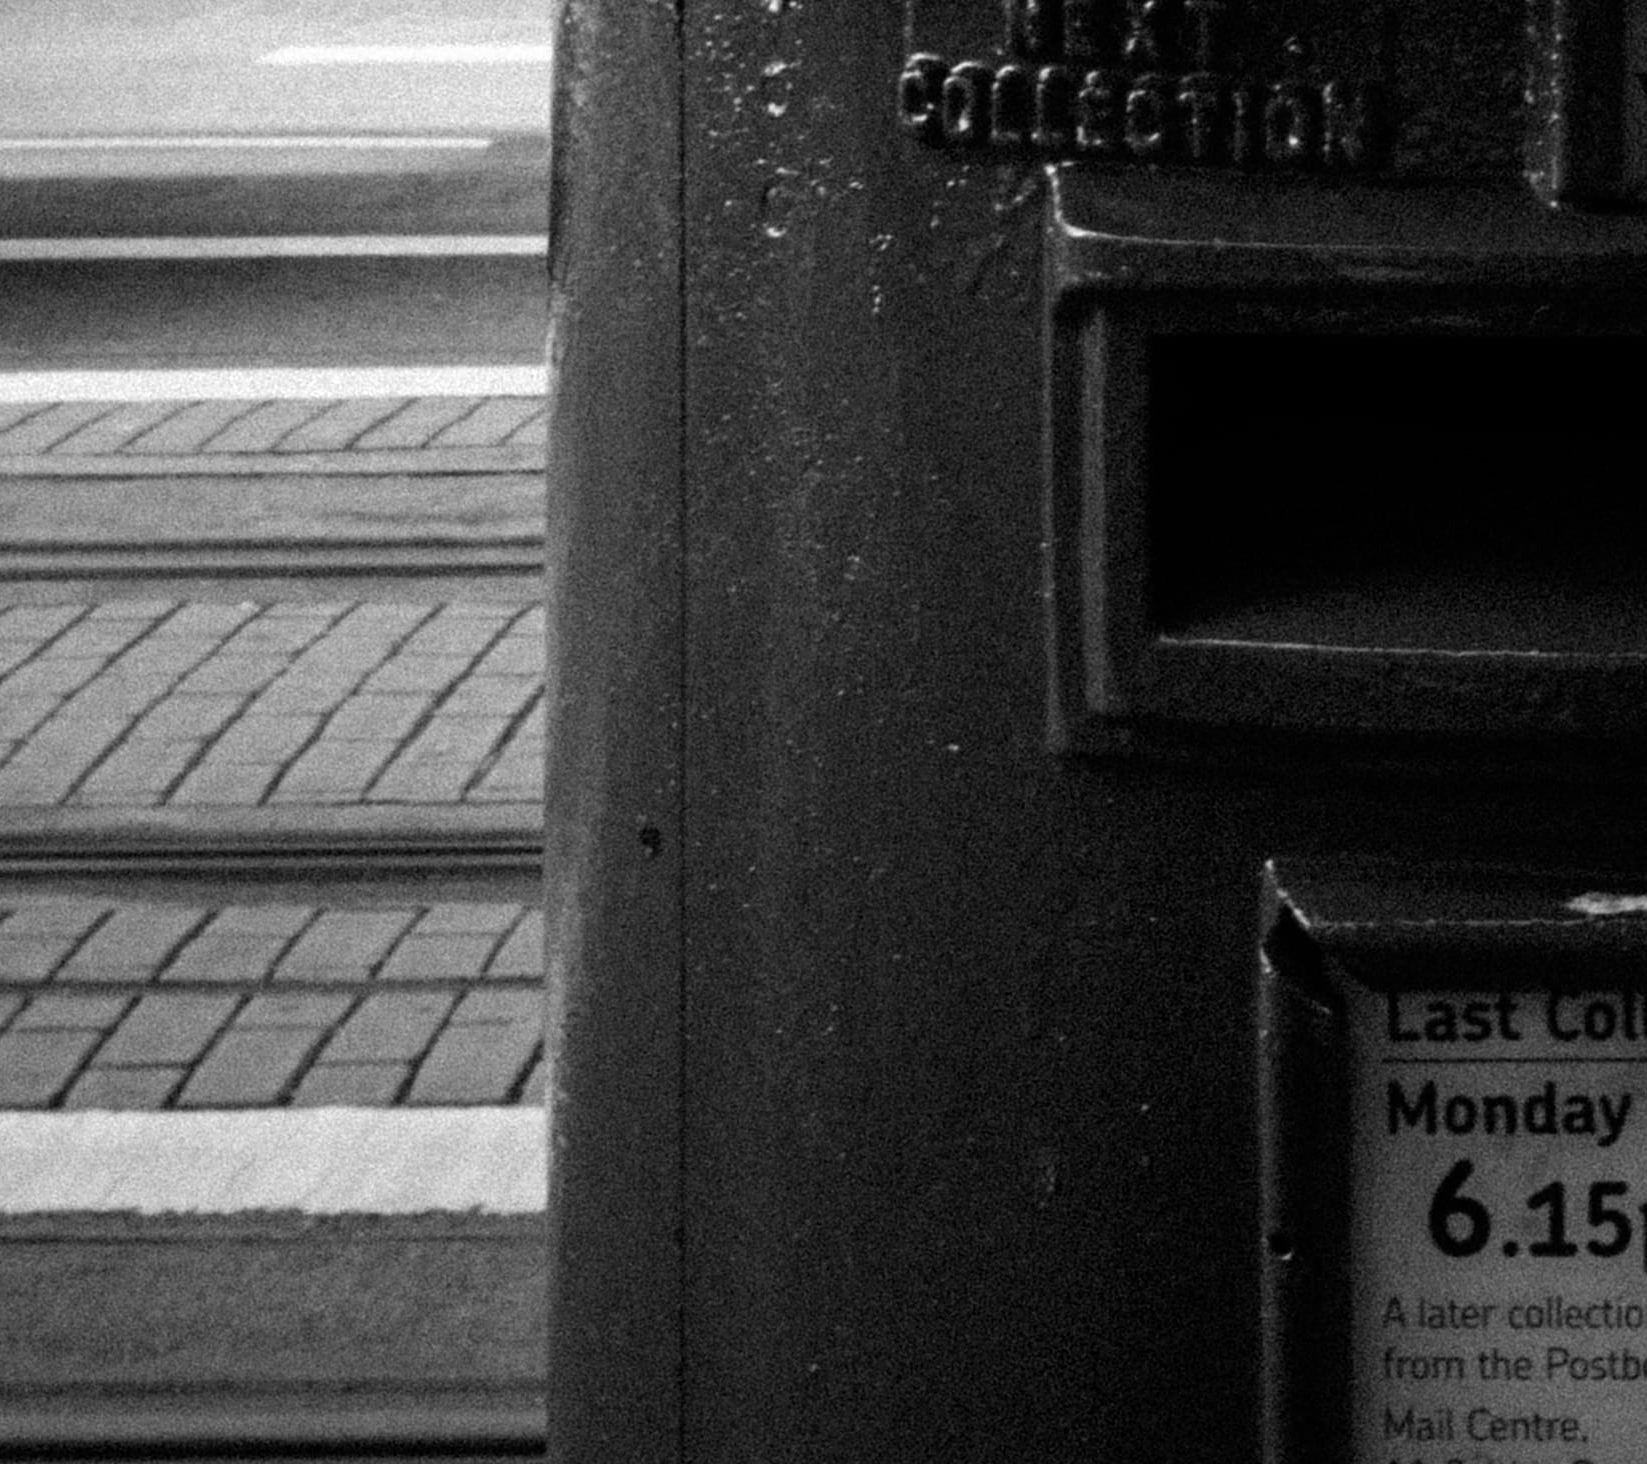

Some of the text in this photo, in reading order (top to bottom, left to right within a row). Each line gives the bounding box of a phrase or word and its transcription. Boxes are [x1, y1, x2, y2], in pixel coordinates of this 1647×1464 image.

[897, 50, 1369, 166] COLLECTION
[1386, 989, 1521, 1042] Last
[1386, 1078, 1633, 1148] Monday
[1382, 1296, 1407, 1330] A
[1417, 1295, 1497, 1331] later
[1382, 1345, 1465, 1381] from
[1476, 1348, 1533, 1382] the
[1382, 1405, 1455, 1442] Mail
